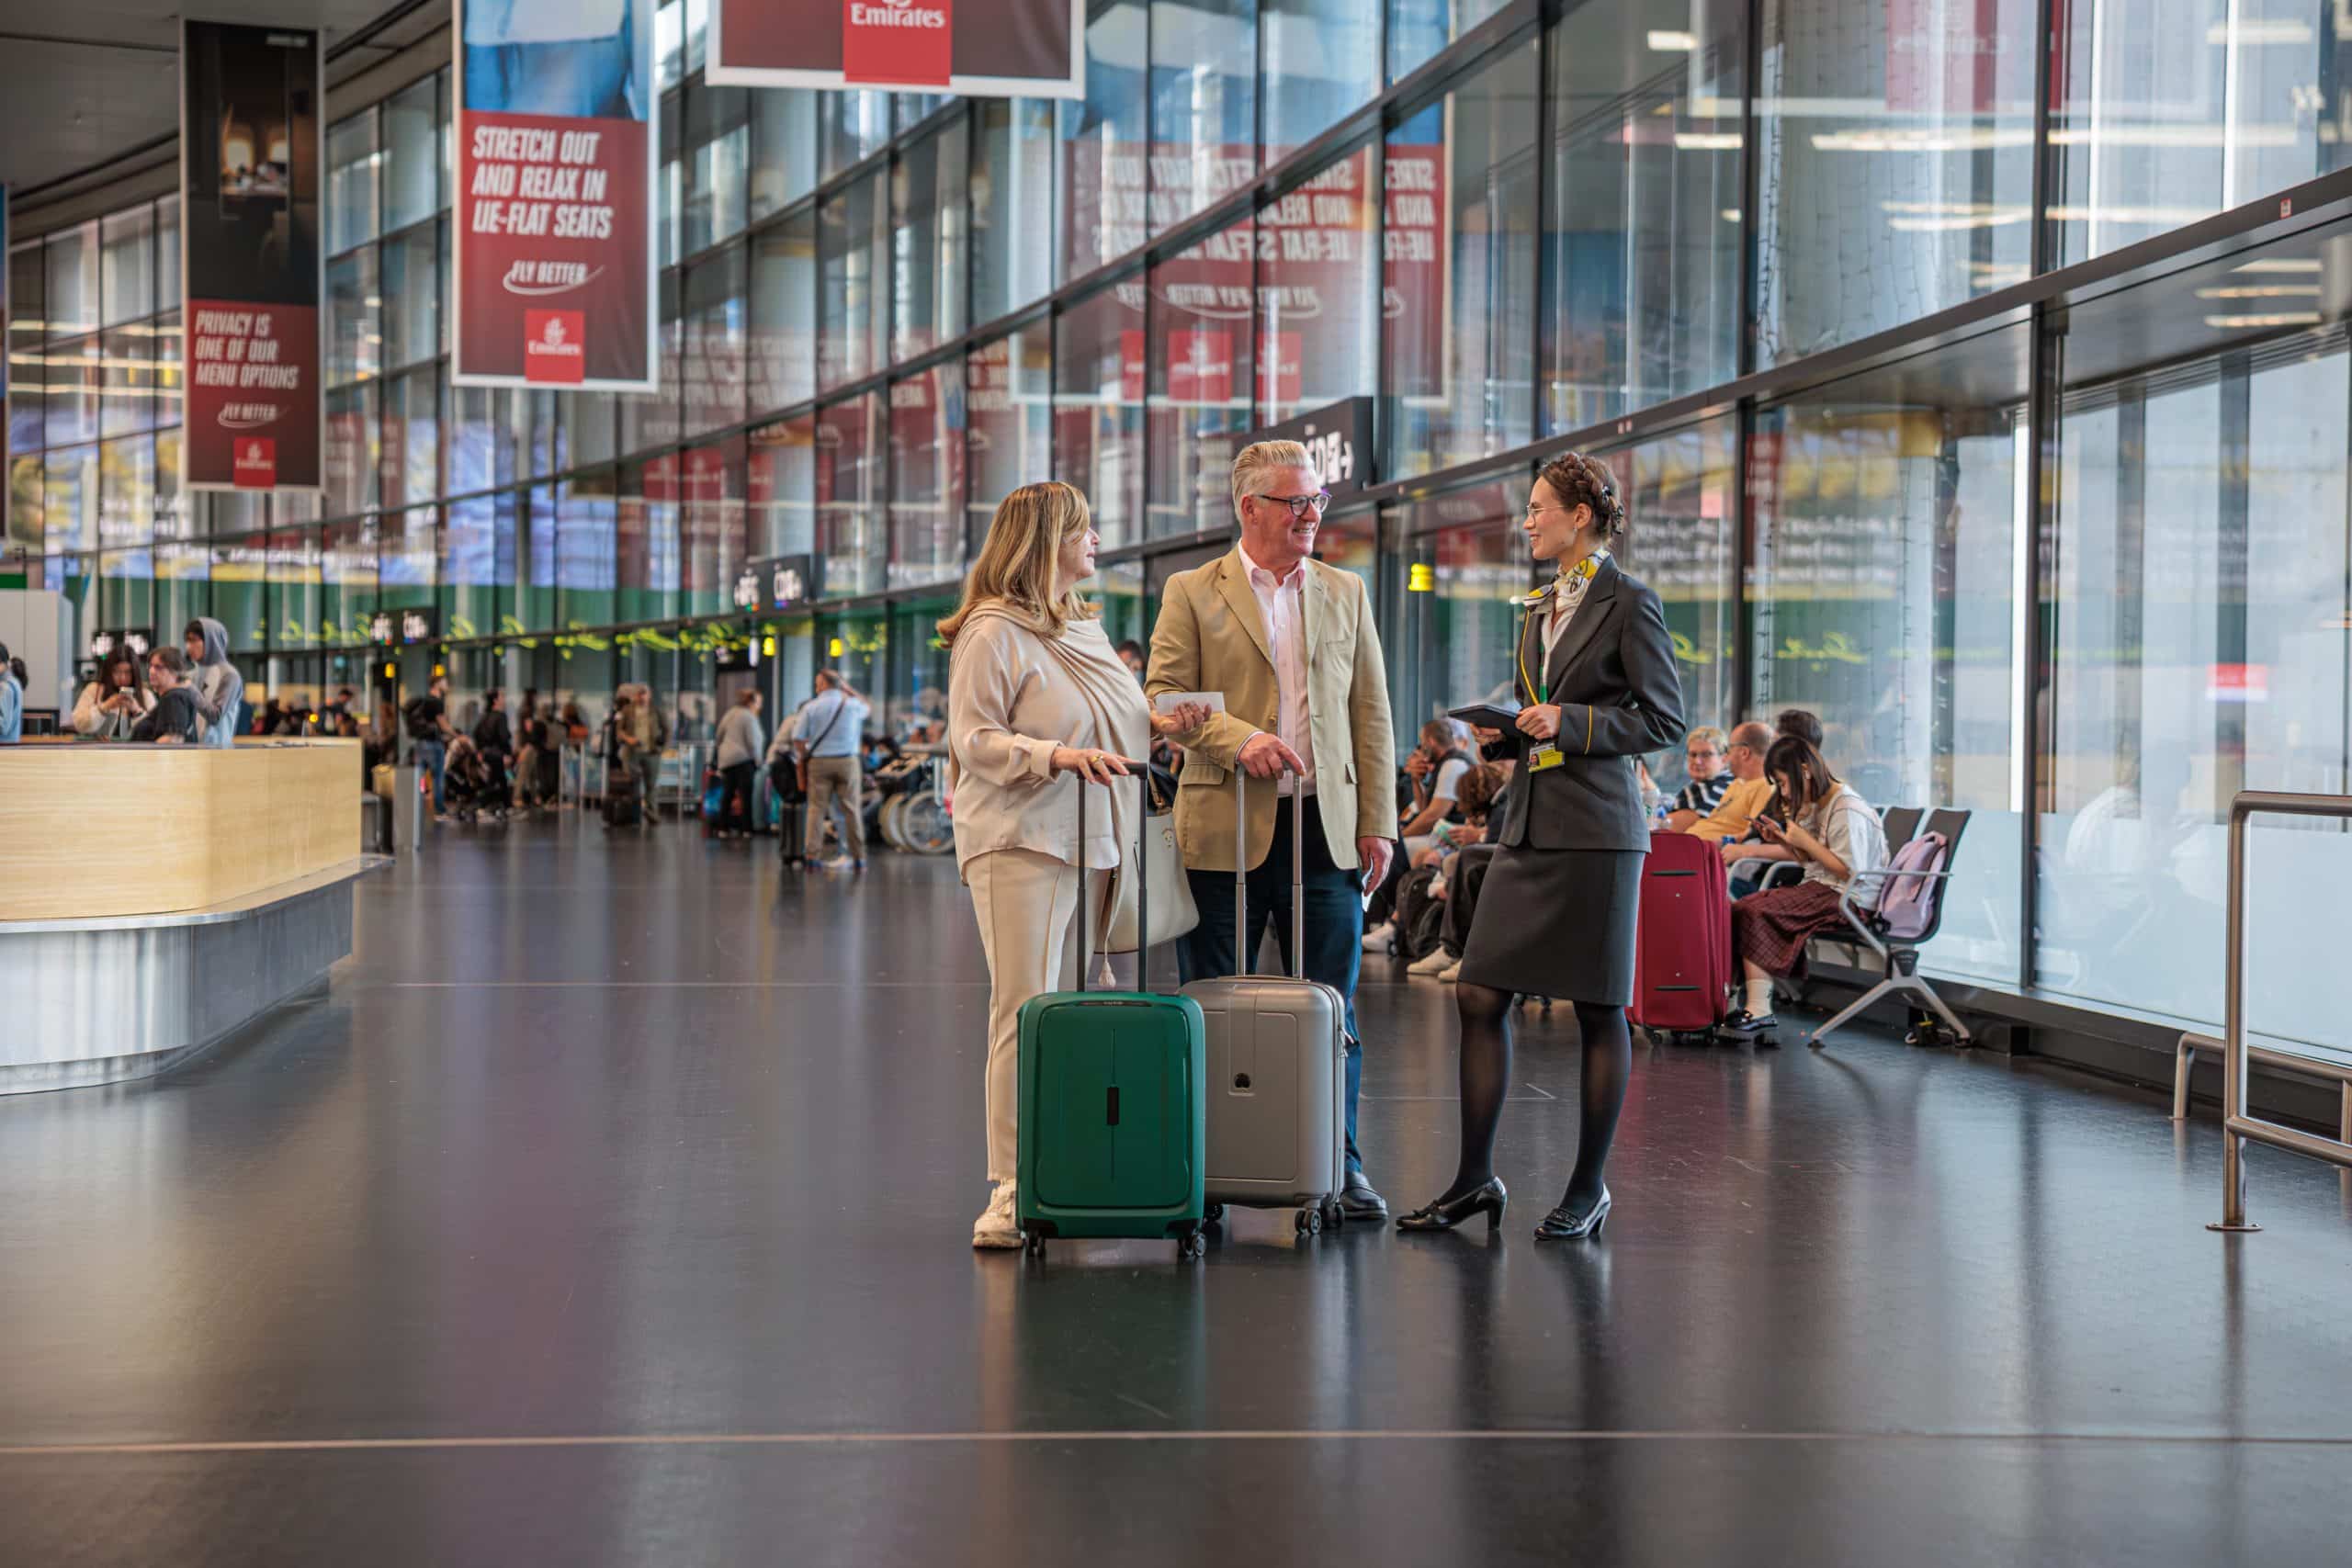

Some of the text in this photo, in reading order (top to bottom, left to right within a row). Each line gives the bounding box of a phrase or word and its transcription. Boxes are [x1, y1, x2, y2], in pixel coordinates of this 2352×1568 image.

[851, 2, 945, 28] Emirates
[472, 125, 601, 164] STRETCH OUT
[471, 164, 607, 201] AND RELAX IN
[472, 199, 614, 239] LIE-FLAT SEATS
[511, 259, 587, 284] FLY BETTER
[195, 310, 272, 337] PRIVACY IS
[195, 335, 279, 362] ONE OF OUR
[195, 362, 300, 389] MENU OPTIONS
